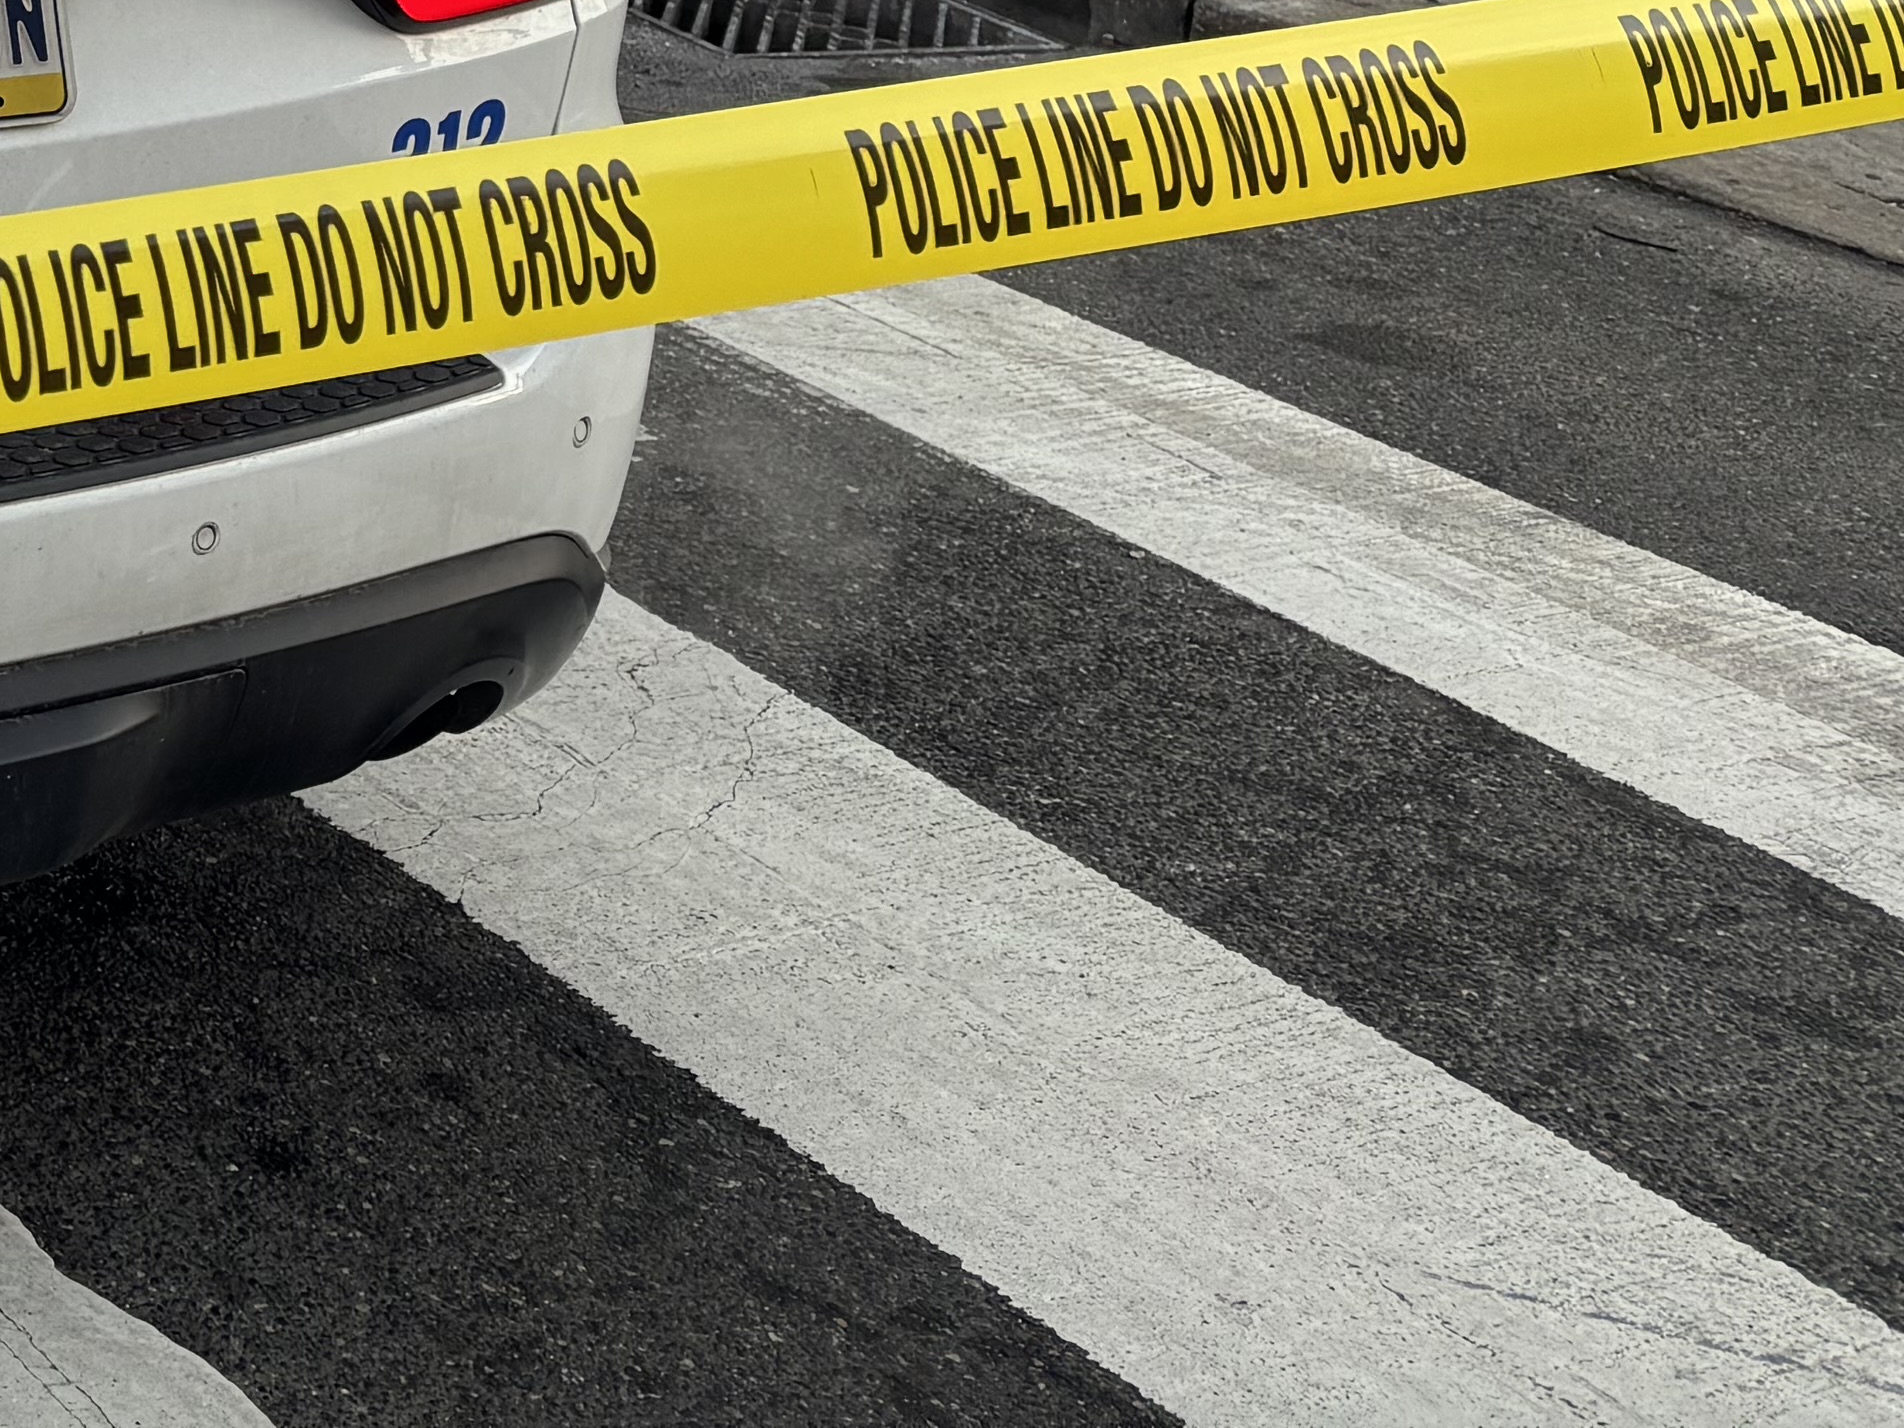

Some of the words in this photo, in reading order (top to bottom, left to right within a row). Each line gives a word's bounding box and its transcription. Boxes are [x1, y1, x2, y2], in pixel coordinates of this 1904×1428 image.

[843, 107, 1032, 260] POLICE
[1016, 89, 1143, 231] LINE
[1128, 76, 1214, 213] DO
[1200, 62, 1310, 199] NOT
[1302, 38, 1468, 187] CROSS
[144, 217, 283, 374] LINE
[274, 202, 365, 351] DO
[361, 186, 475, 338] NOT
[477, 157, 657, 318] CROSS
